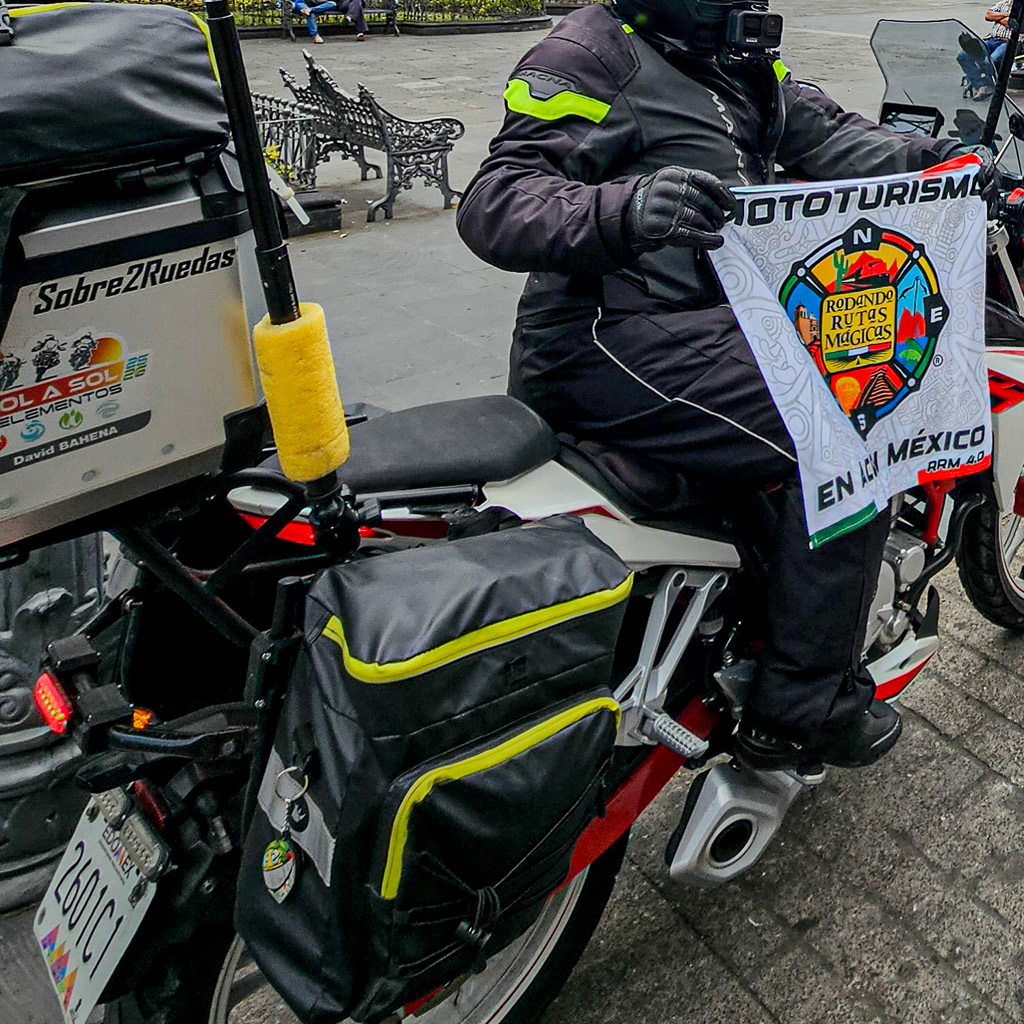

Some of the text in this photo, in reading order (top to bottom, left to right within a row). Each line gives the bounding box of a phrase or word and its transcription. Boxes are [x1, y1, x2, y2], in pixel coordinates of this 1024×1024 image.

[853, 228, 872, 245] N
[33, 246, 236, 316] Sobre2Ruedas
[930, 306, 944, 323] E
[125, 353, 149, 370] 25
[41, 385, 62, 401] A
[69, 367, 119, 393] SOL
[13, 425, 119, 467] David BAHENA
[818, 471, 855, 512] EN
[887, 424, 986, 467] MÉXICO
[926, 450, 986, 472] RRM 4.0
